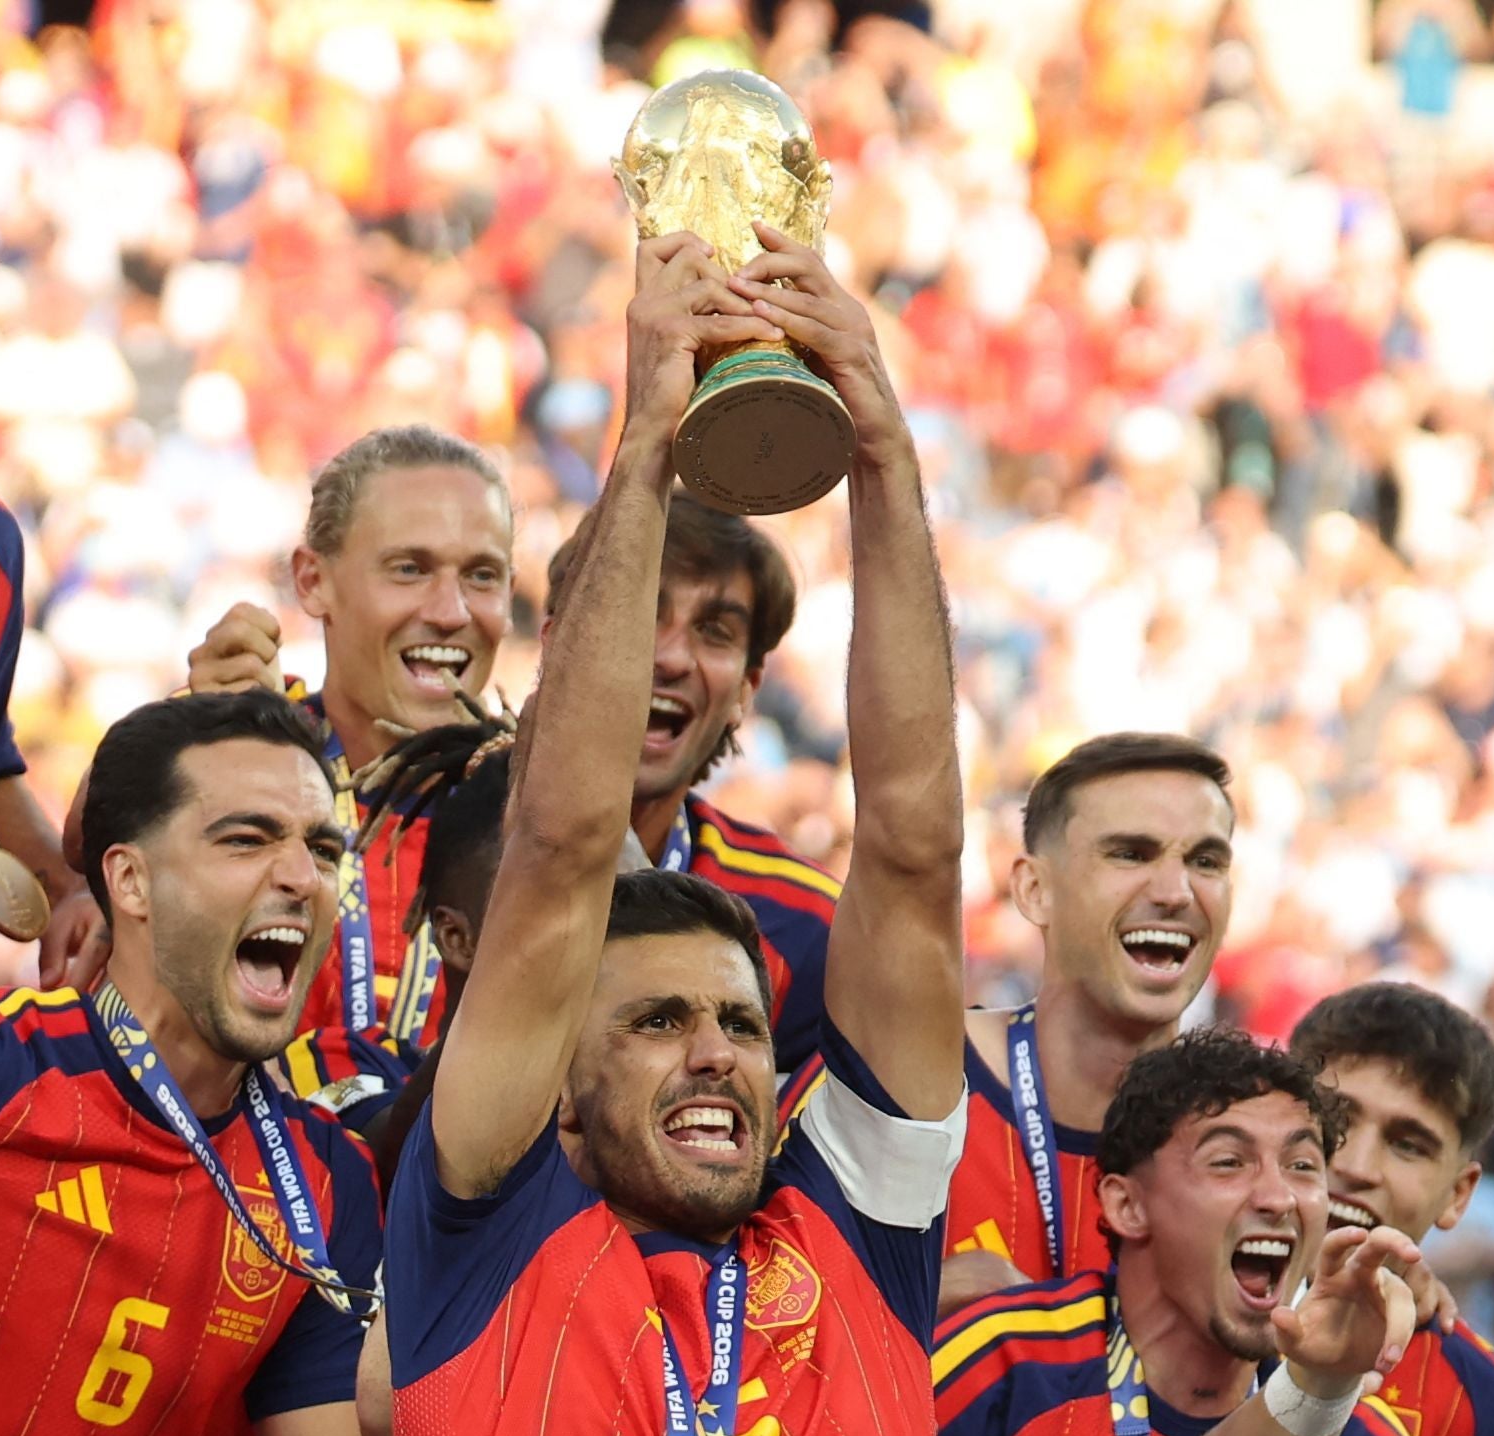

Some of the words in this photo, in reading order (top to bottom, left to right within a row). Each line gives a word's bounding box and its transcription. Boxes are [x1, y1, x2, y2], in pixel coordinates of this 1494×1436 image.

[349, 937, 368, 980] FIFA
[351, 981, 369, 1031] WOR
[1014, 1039, 1039, 1107] 2026
[156, 1083, 198, 1143] 2026
[259, 1117, 280, 1147] CUP
[1026, 1109, 1046, 1149] CUP
[193, 1140, 218, 1174] CUP
[271, 1145, 303, 1202] WORLD
[1030, 1150, 1054, 1223] WORLD
[289, 1200, 315, 1235] FIFA
[717, 1285, 737, 1322] CUP
[75, 1297, 170, 1427] 6
[711, 1322, 734, 1387] 2026
[668, 1388, 690, 1432] FIFA
